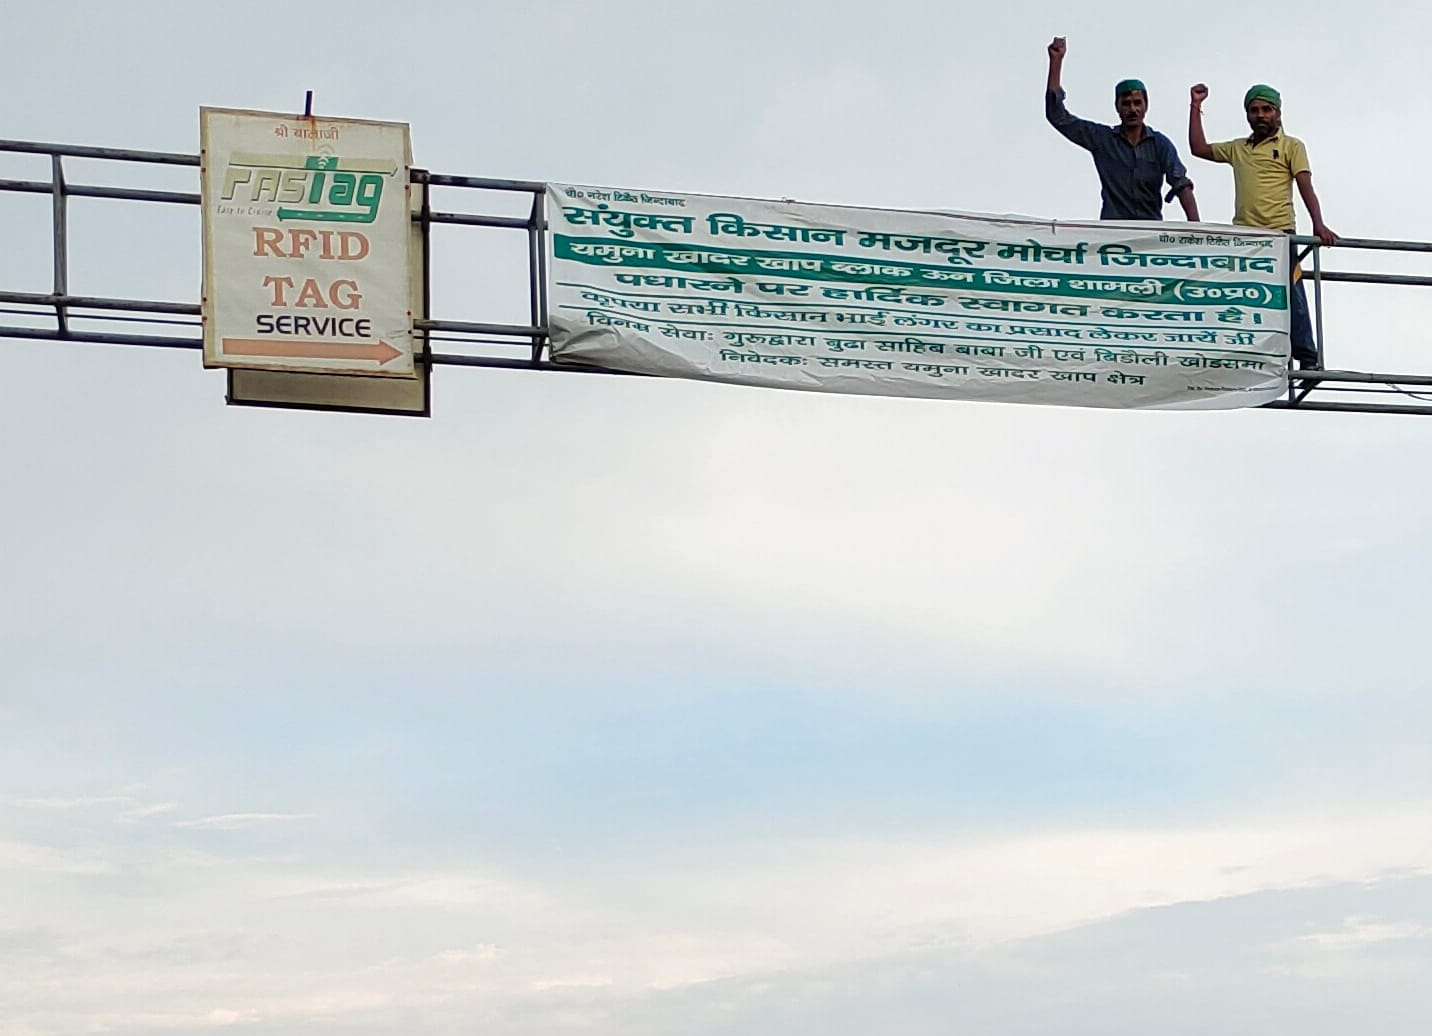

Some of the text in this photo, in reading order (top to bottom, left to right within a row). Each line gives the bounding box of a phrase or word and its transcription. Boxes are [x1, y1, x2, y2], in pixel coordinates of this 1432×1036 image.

[253, 227, 370, 262] RFID
[561, 203, 1277, 274] संयुक्त किसान मजदूर मोर्चा जिन्दाबाद
[569, 242, 657, 264] यमुना
[663, 250, 750, 266] खादर
[755, 256, 824, 272] खाप
[982, 270, 1060, 289] जिला
[1068, 278, 1166, 296] शामली
[263, 276, 363, 310] TAG
[614, 273, 745, 294] पधारने
[756, 281, 814, 297] पर
[957, 296, 1091, 317] स्वागत
[1099, 306, 1203, 322] करता
[256, 314, 371, 338] SERVICE
[667, 300, 729, 316] सभी
[734, 304, 830, 323] किसान
[835, 311, 890, 326] भाई
[893, 314, 959, 331] लंगर
[966, 322, 1002, 333] का
[1004, 324, 1083, 340] प्रसाद
[1088, 327, 1158, 342] लेकर
[1224, 332, 1255, 346] जी
[874, 337, 947, 354] साहिब
[953, 343, 1006, 357] बाबा
[1014, 345, 1045, 360] जी
[1052, 347, 1086, 362] एवं
[815, 356, 894, 370] समस्त
[901, 362, 969, 378] यमुना
[976, 366, 1042, 380] खादर
[1048, 370, 1096, 383] खाप
[1106, 370, 1148, 386] क्षेत्र
